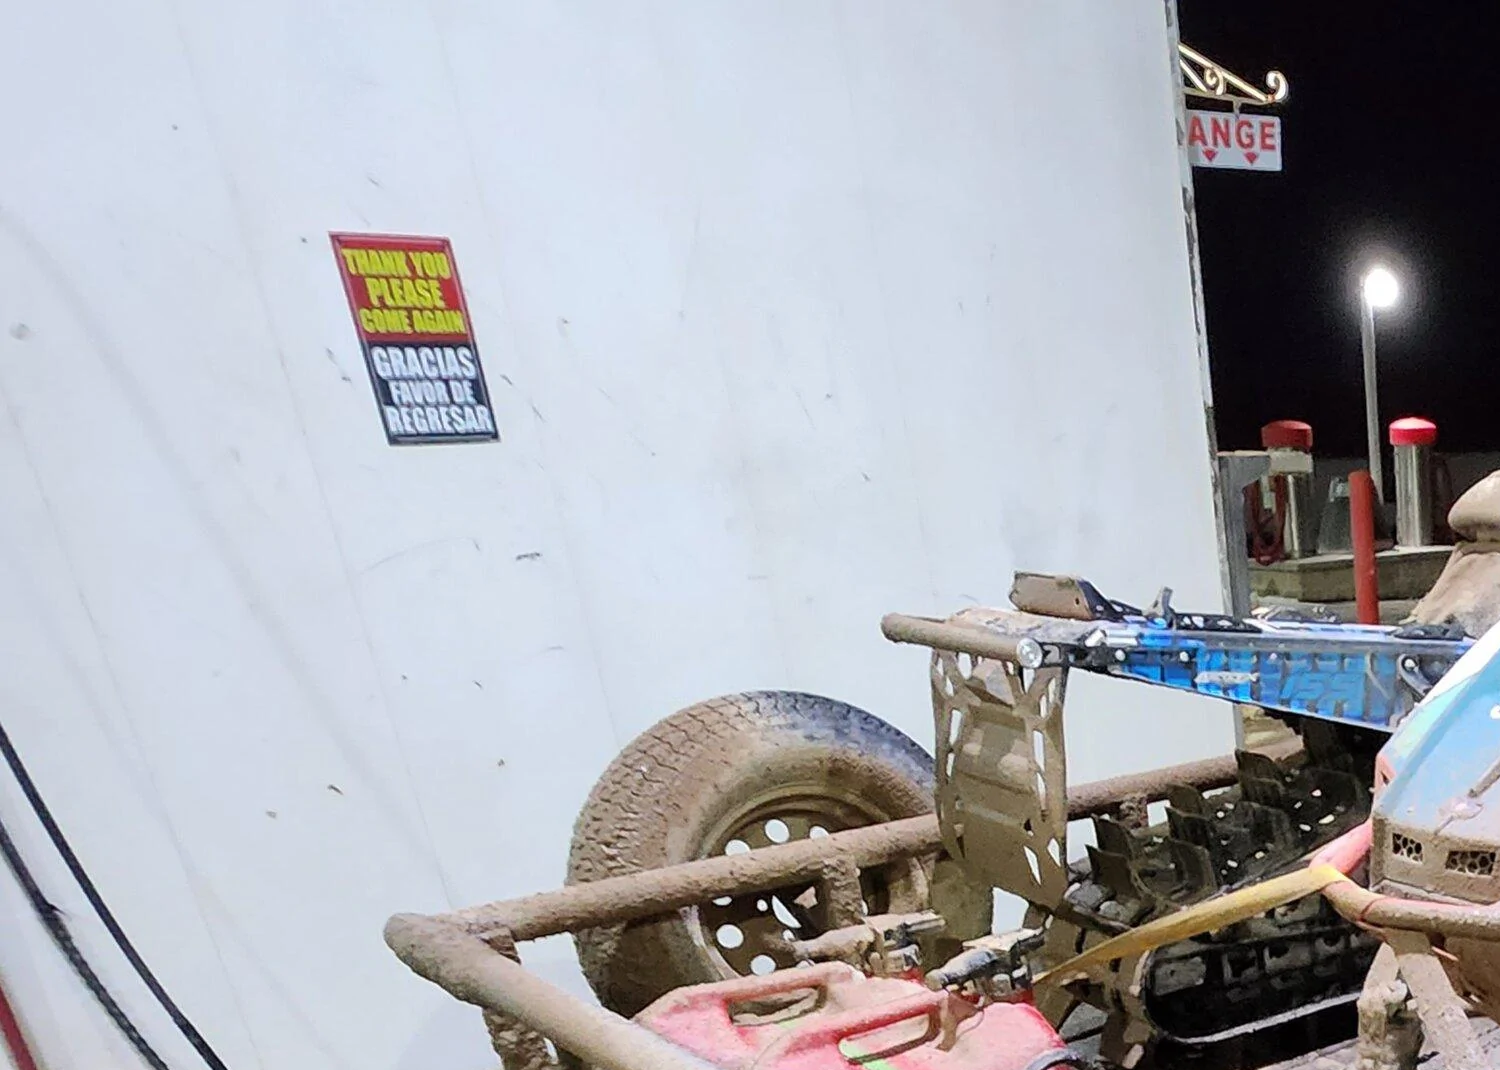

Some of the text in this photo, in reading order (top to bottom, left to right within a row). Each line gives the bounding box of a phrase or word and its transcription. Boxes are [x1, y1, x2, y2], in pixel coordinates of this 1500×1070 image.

[341, 248, 452, 280] THANK YOU
[364, 277, 446, 308] PLEASE
[359, 308, 466, 334] COME AGAIN
[371, 346, 477, 380] GRACIAS
[388, 380, 477, 405] FAVOR DE
[383, 404, 496, 434] REGRESAR
